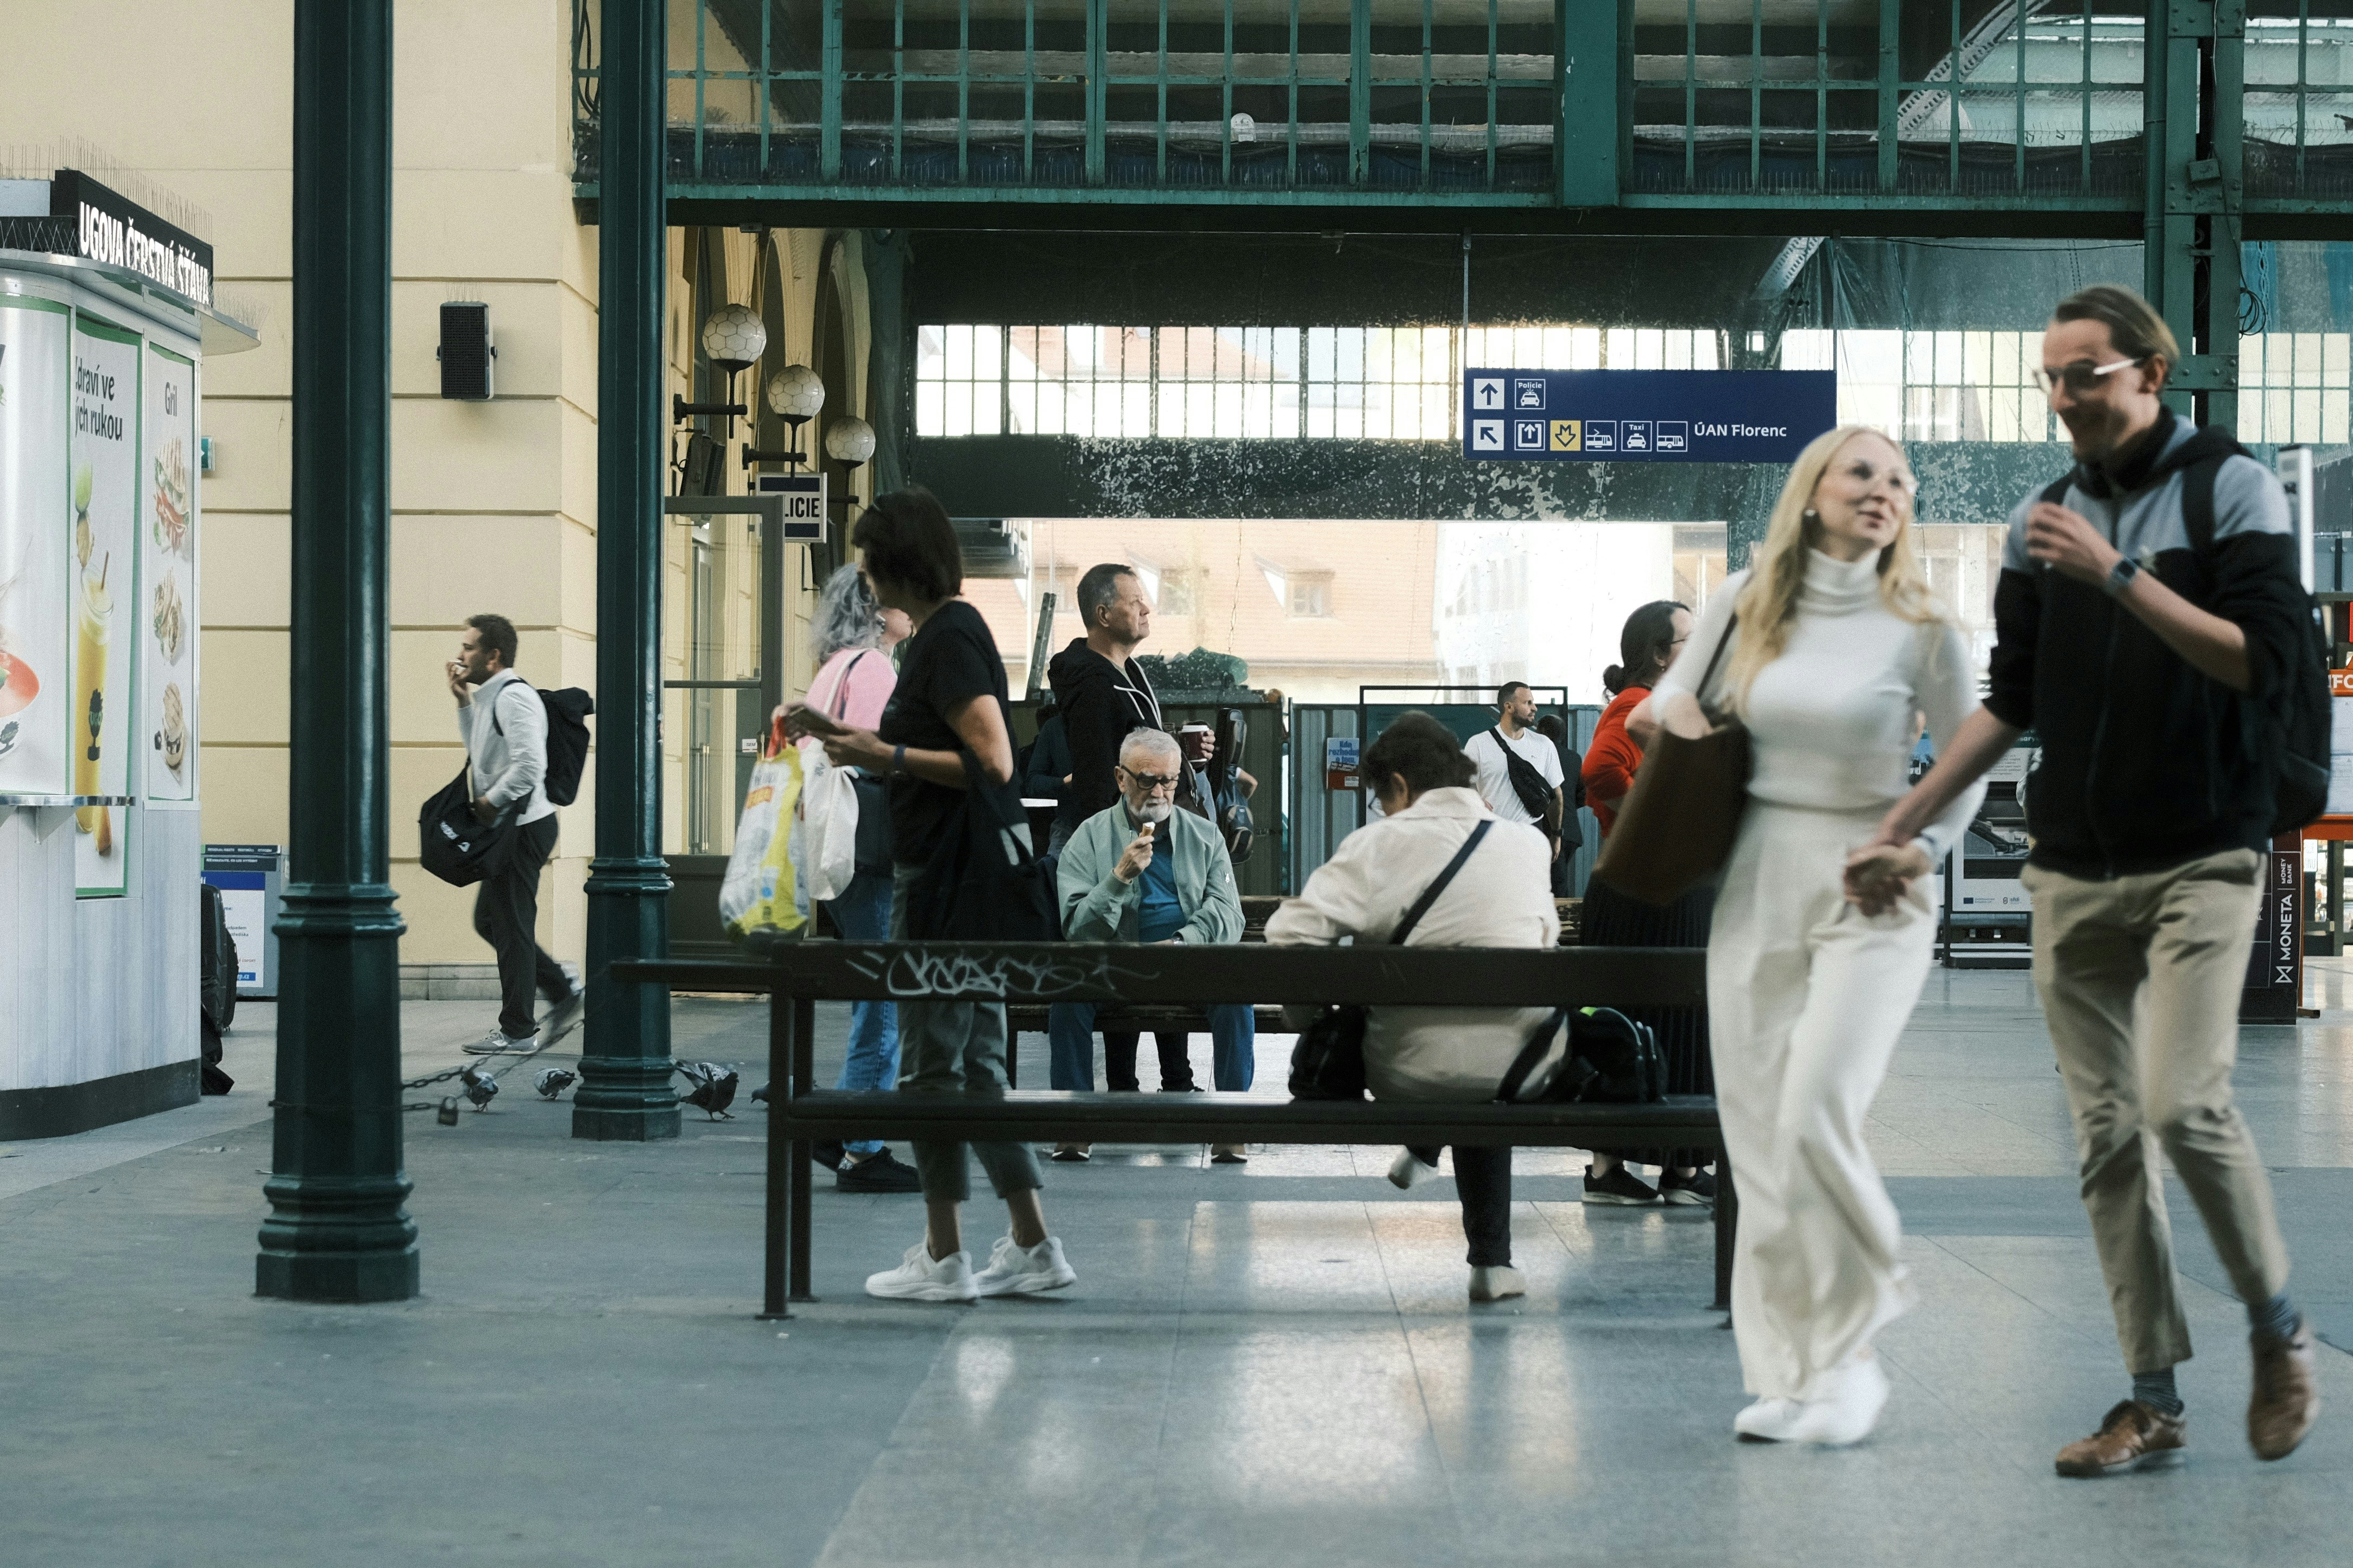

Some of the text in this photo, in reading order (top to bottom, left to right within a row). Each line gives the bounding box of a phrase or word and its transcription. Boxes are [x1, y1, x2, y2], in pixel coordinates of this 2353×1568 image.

[80, 201, 209, 304] UGOVA ČERSTVÁ ŠŤÁVA
[102, 375, 115, 401] ve
[165, 382, 177, 417] Gril
[91, 404, 123, 441] rukou
[1694, 422, 1787, 437] ÚAN Florenc
[785, 497, 820, 518] ICIE
[2280, 894, 2292, 960] MONETA
